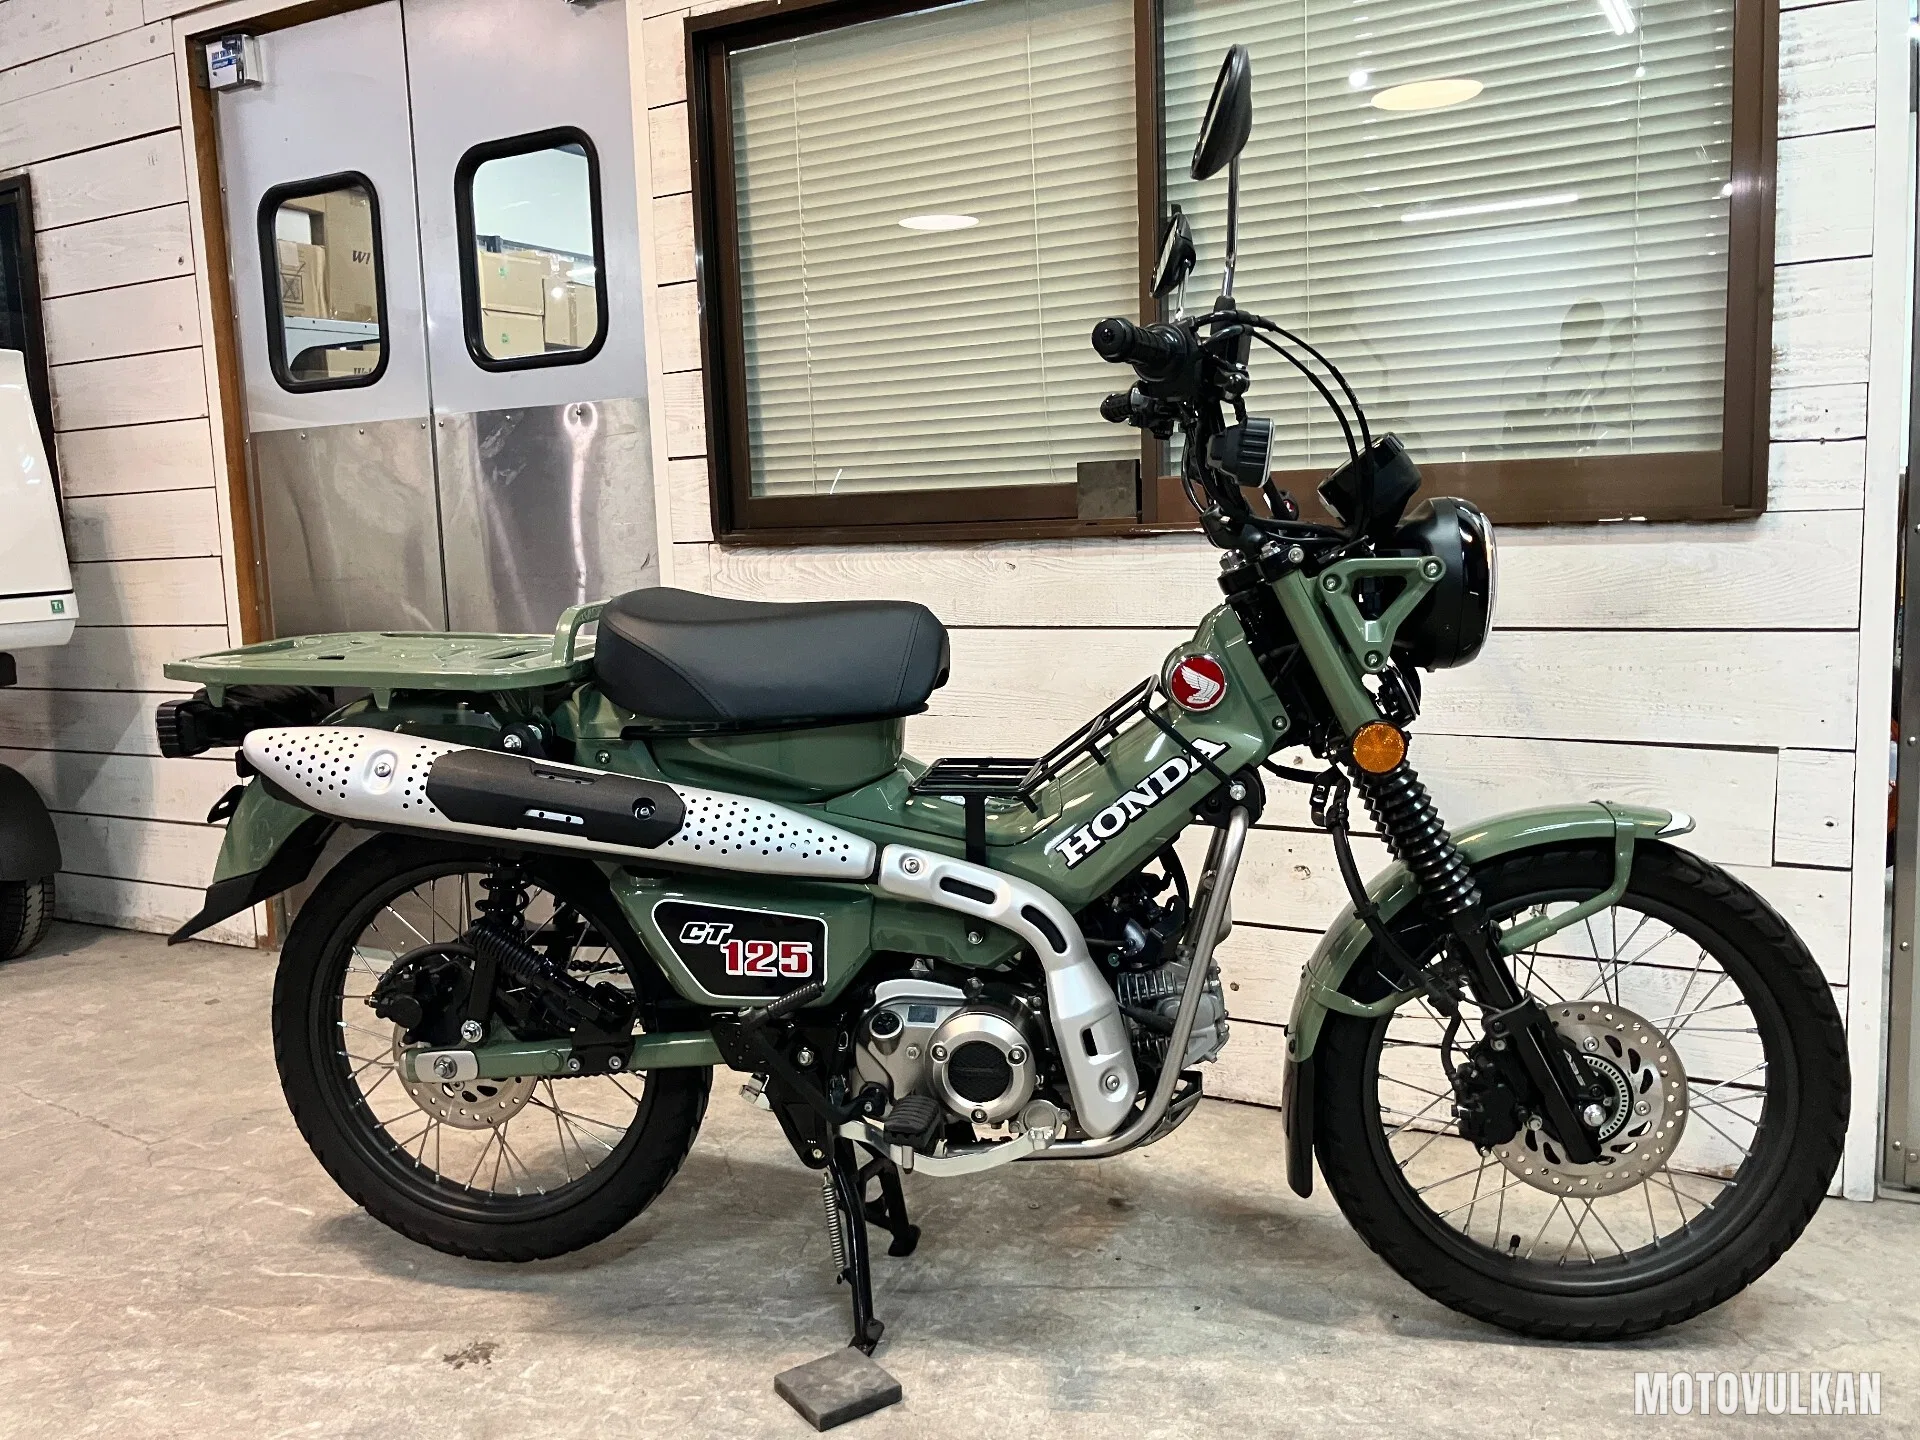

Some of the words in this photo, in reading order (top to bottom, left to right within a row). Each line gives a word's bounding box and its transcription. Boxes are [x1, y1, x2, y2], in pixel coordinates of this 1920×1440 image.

[1055, 737, 1230, 868] HONDA
[679, 921, 733, 945] CT
[720, 939, 812, 977] 125
